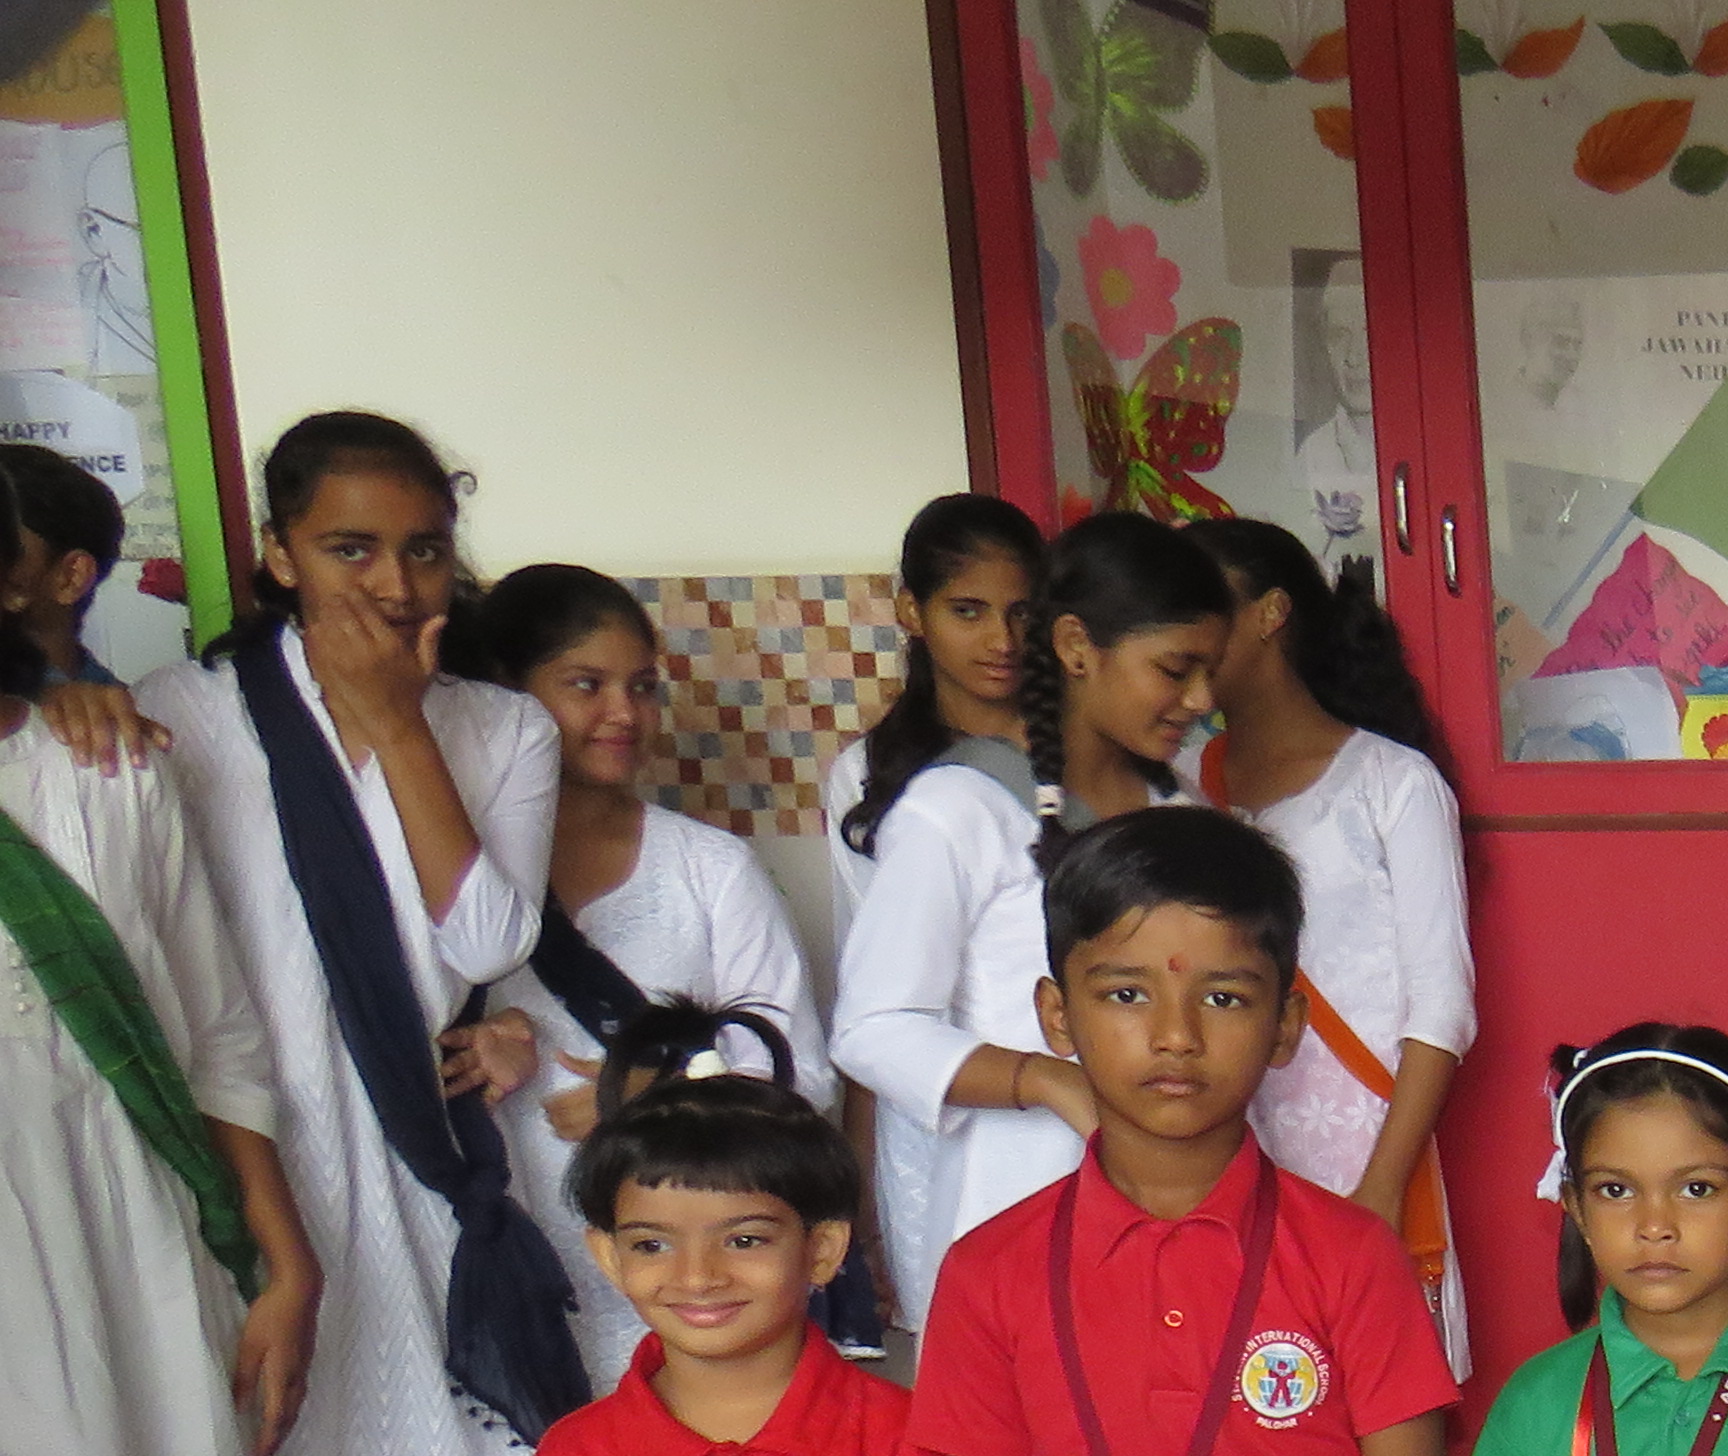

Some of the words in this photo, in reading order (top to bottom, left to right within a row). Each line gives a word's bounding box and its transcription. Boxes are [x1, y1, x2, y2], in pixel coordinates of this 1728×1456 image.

[0, 421, 71, 440] HAPPY
[1245, 1330, 1326, 1364] INTERNATIONAL
[1314, 1362, 1330, 1406] SCHOOL
